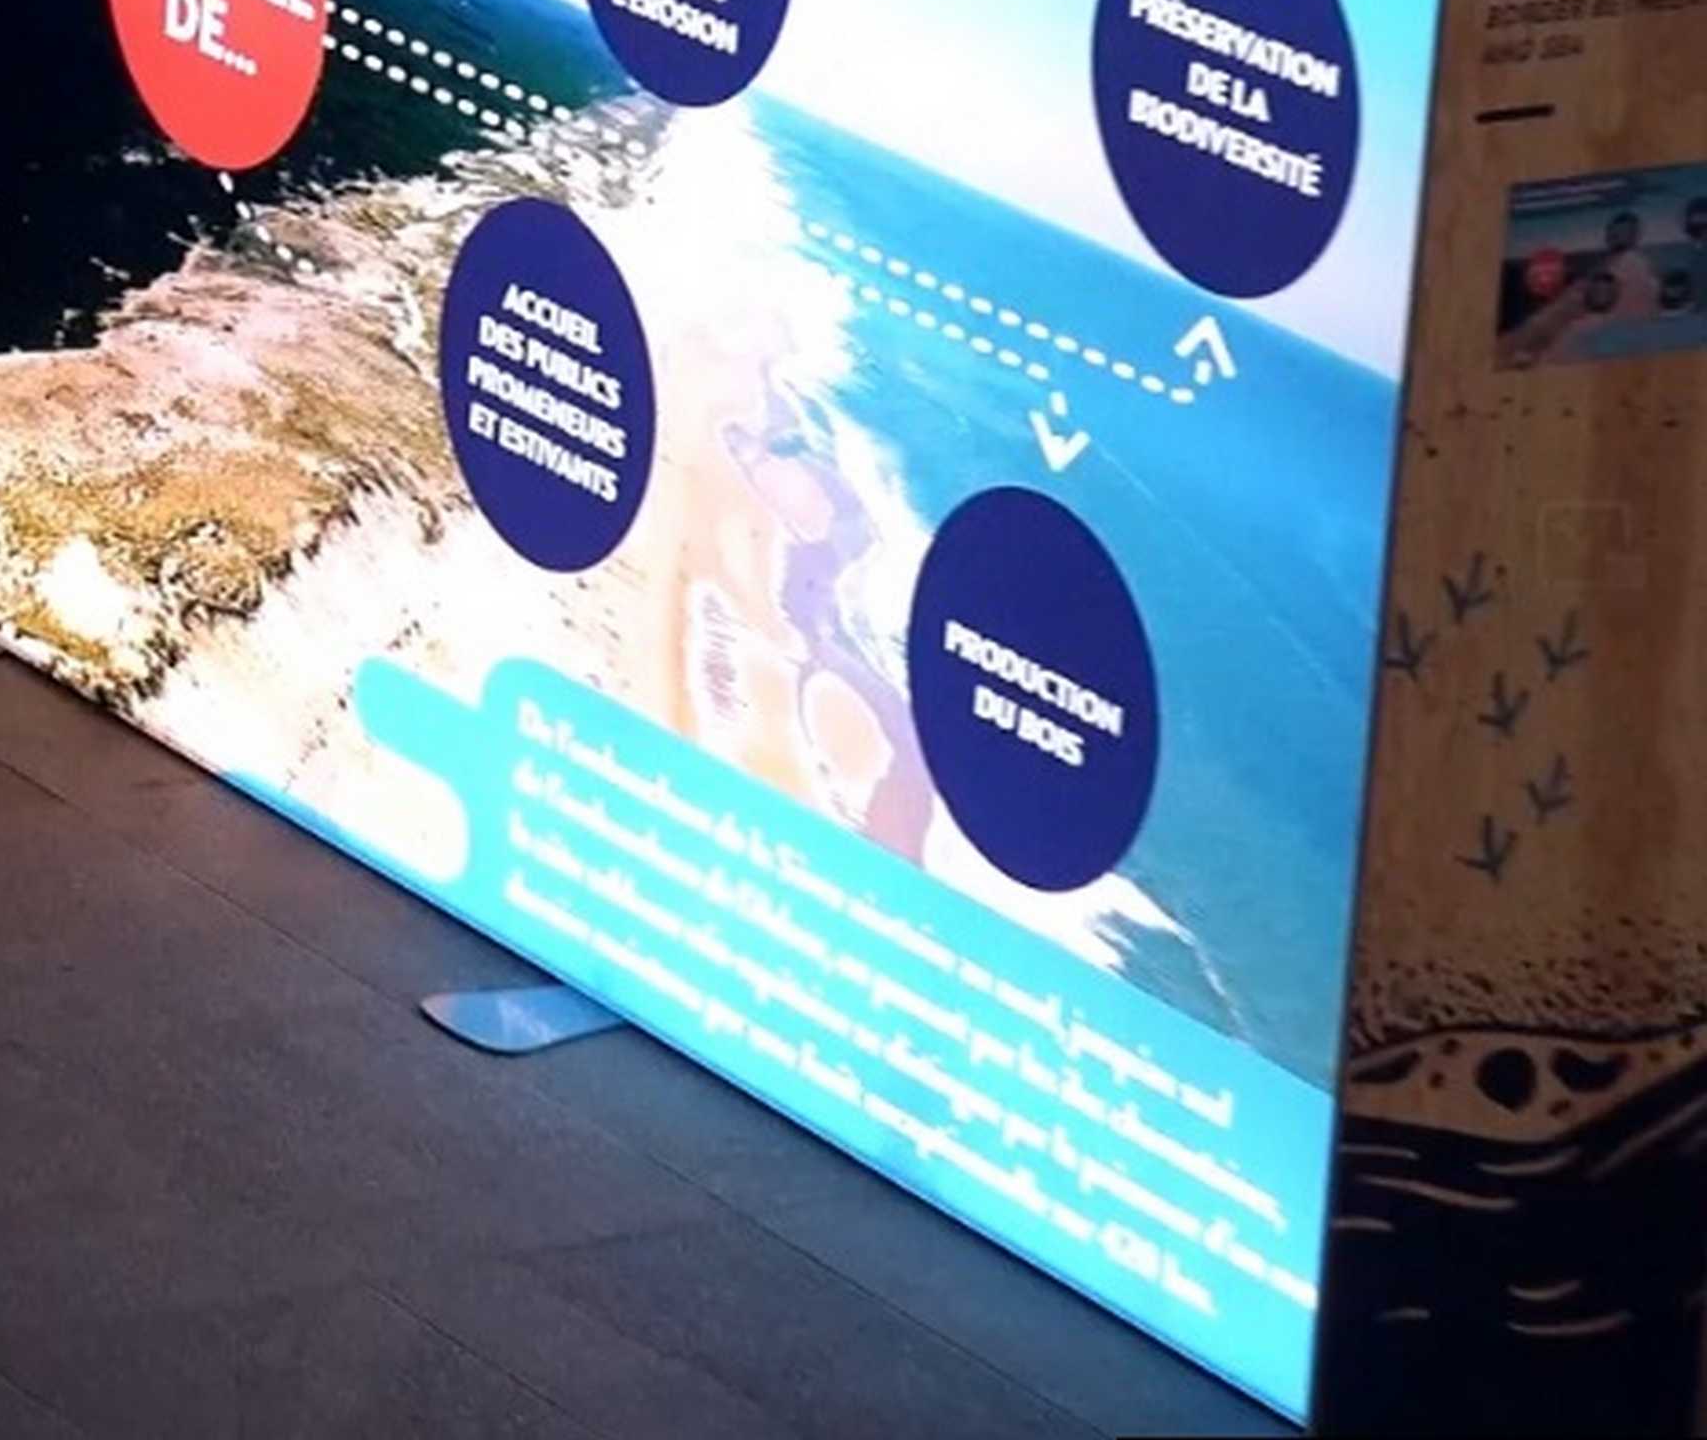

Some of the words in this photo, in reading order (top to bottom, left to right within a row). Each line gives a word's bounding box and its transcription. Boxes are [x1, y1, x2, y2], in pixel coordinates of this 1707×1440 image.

[1186, 61, 1229, 106] DE
[1231, 79, 1271, 123] LA
[1127, 88, 1324, 198] BIODIVERSITÉ
[478, 315, 525, 364] DES
[525, 336, 622, 410] PUBLICS
[502, 283, 603, 355] ACCUEIL
[467, 355, 627, 460] PROMENEURS
[468, 402, 499, 443] ET
[498, 415, 619, 504] ESTIVANTS
[943, 619, 1124, 738] PRODUCTION
[973, 685, 1017, 730] DU
[1017, 708, 1086, 767] BOIS
